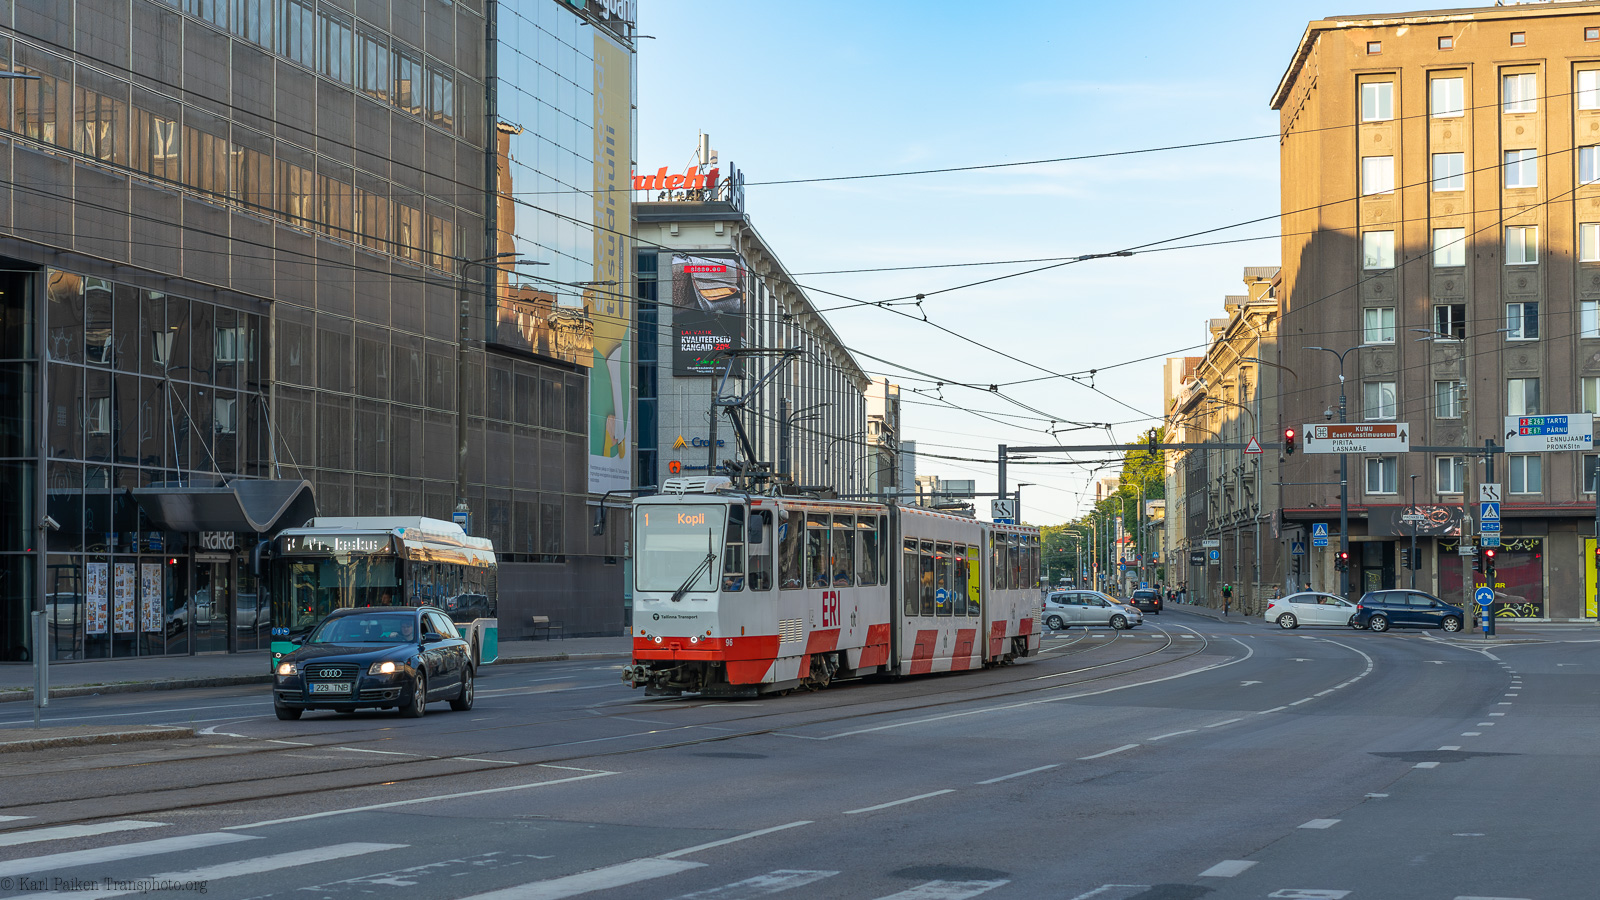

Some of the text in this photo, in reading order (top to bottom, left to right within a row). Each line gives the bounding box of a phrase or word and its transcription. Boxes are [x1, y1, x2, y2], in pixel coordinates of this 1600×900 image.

[606, 124, 615, 316] tasudnulli
[644, 513, 705, 527] 1 Kopli
[823, 590, 840, 627] ERI
[316, 684, 329, 692] 229
